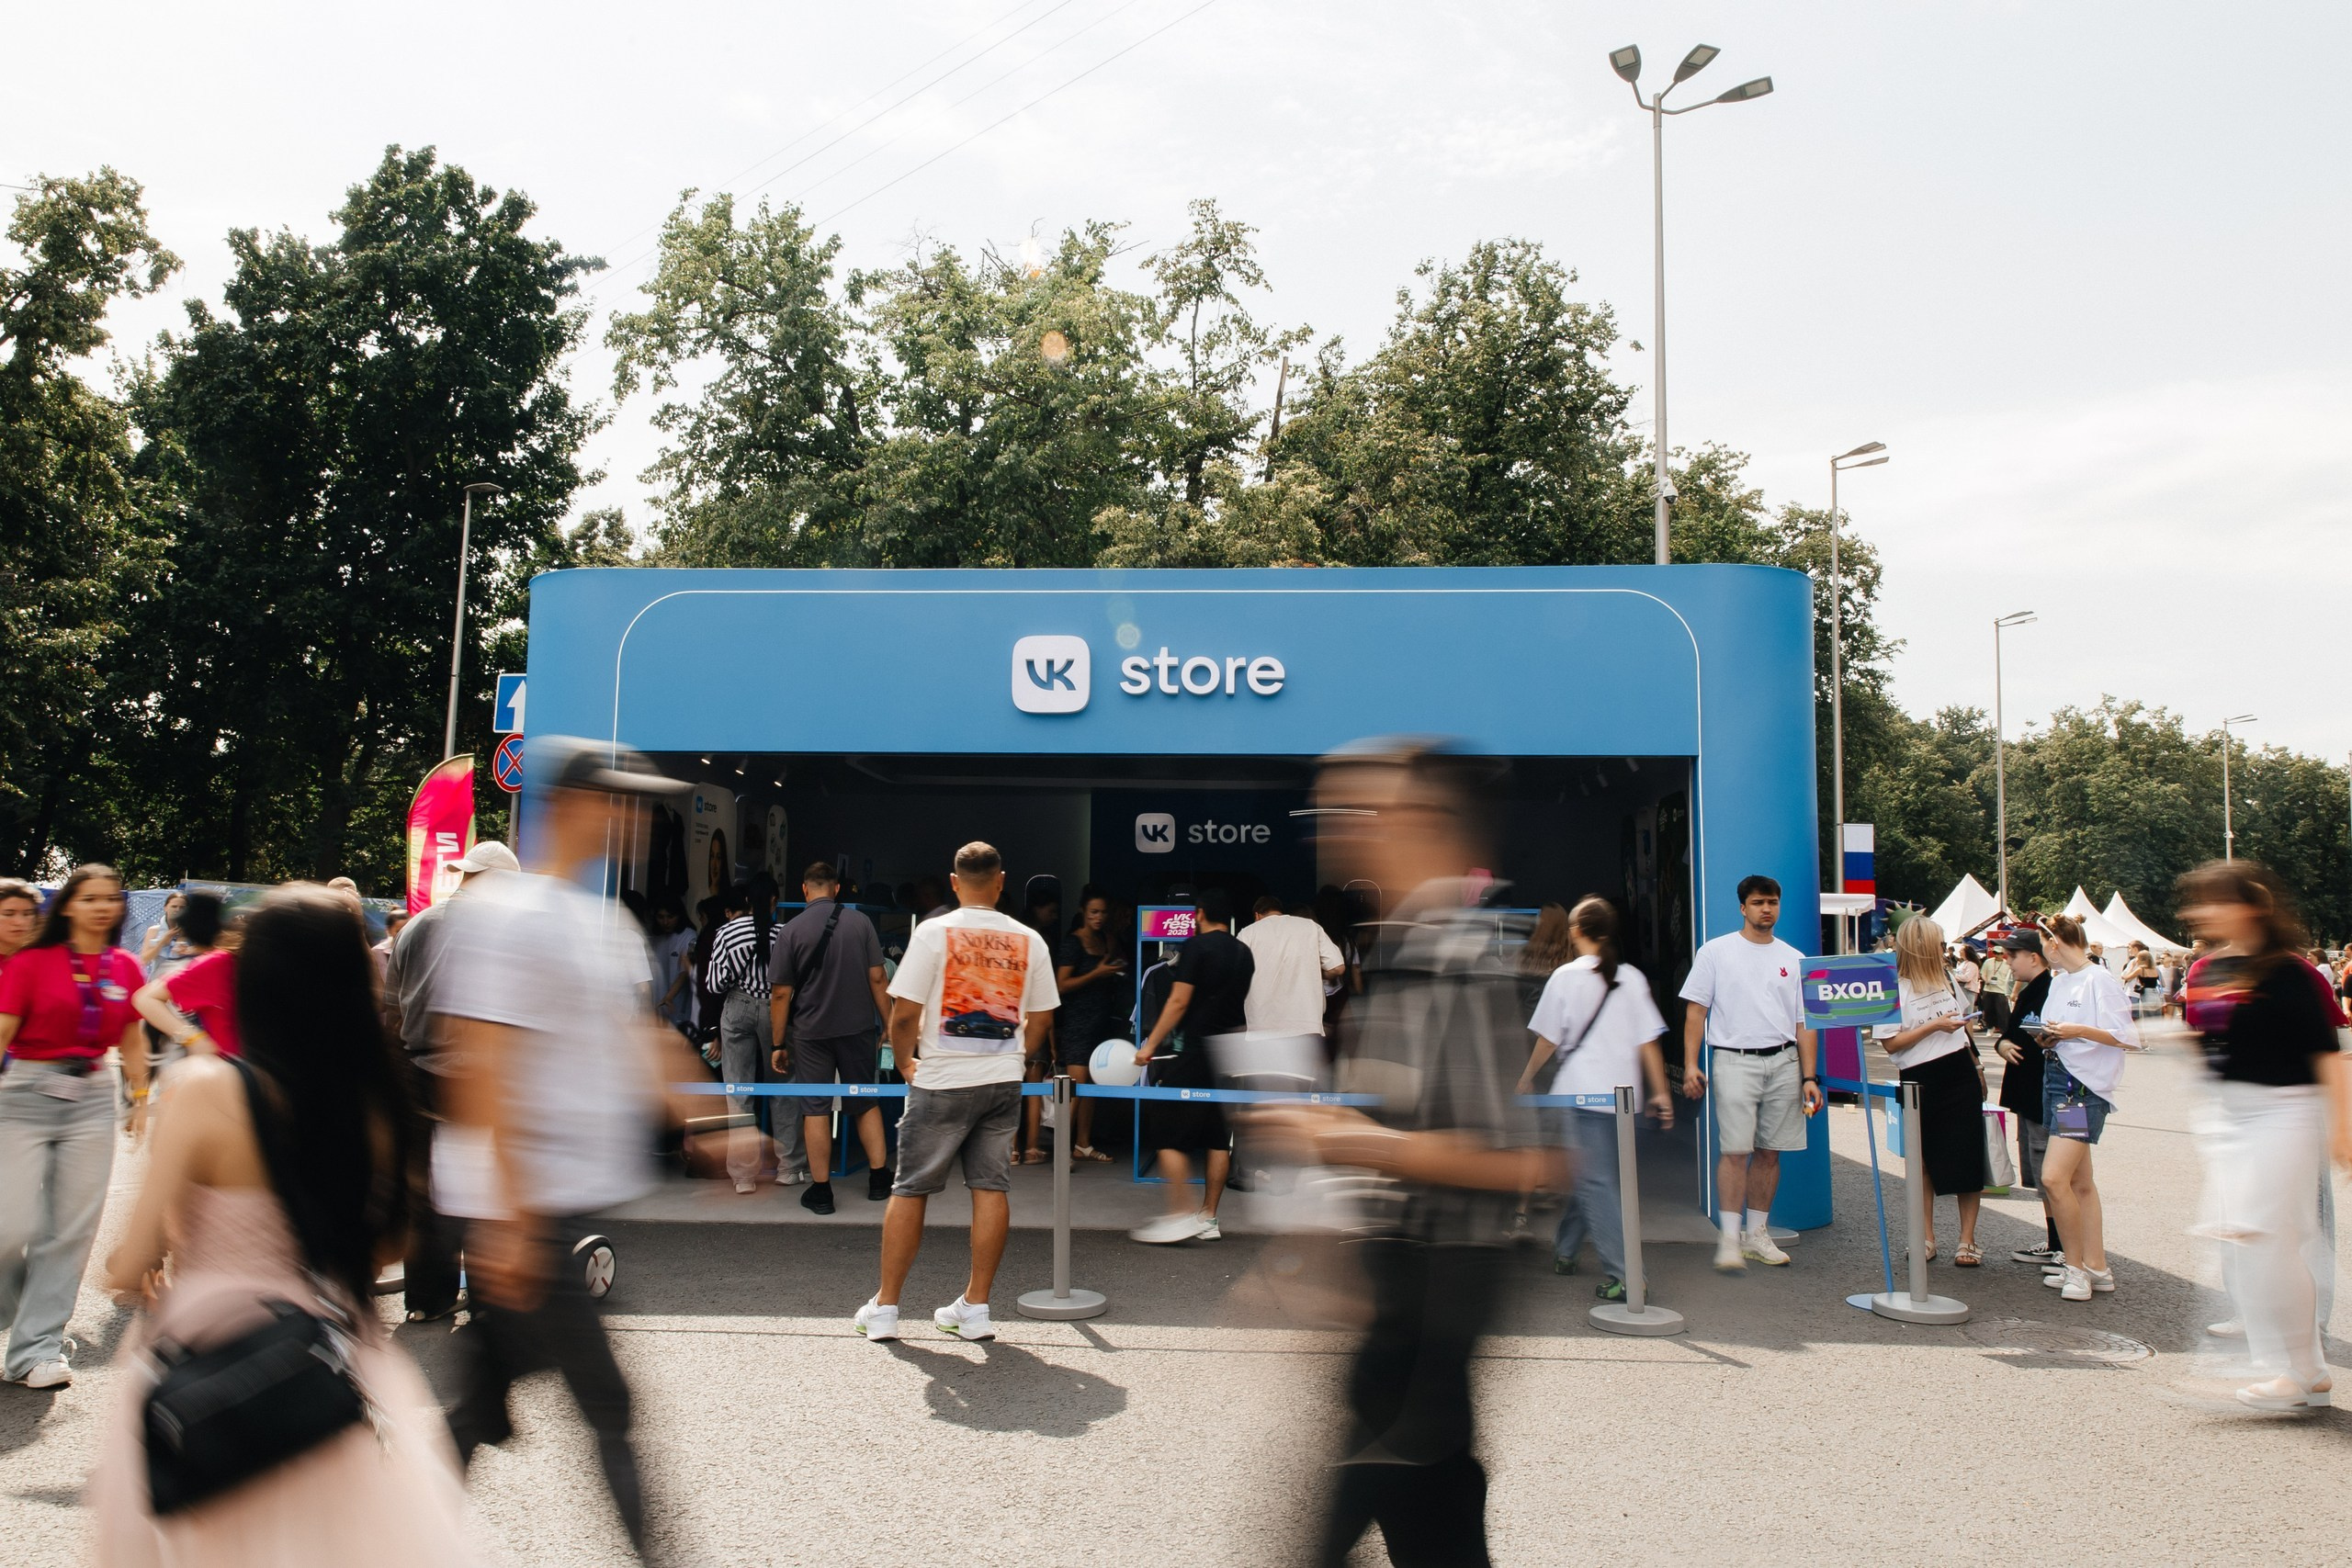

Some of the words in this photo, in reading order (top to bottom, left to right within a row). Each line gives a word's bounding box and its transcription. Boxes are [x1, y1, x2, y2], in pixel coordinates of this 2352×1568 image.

[1024, 658, 1077, 691] VK
[1119, 646, 1285, 695] store
[704, 801, 718, 813] store
[1141, 824, 1170, 843] VK
[1187, 818, 1272, 844] store
[435, 831, 460, 908] ЕТИ
[1161, 918, 1196, 930] fest
[1173, 913, 1193, 921] VK
[1817, 980, 1885, 1002] ВХОД
[1192, 1090, 1211, 1099] store
